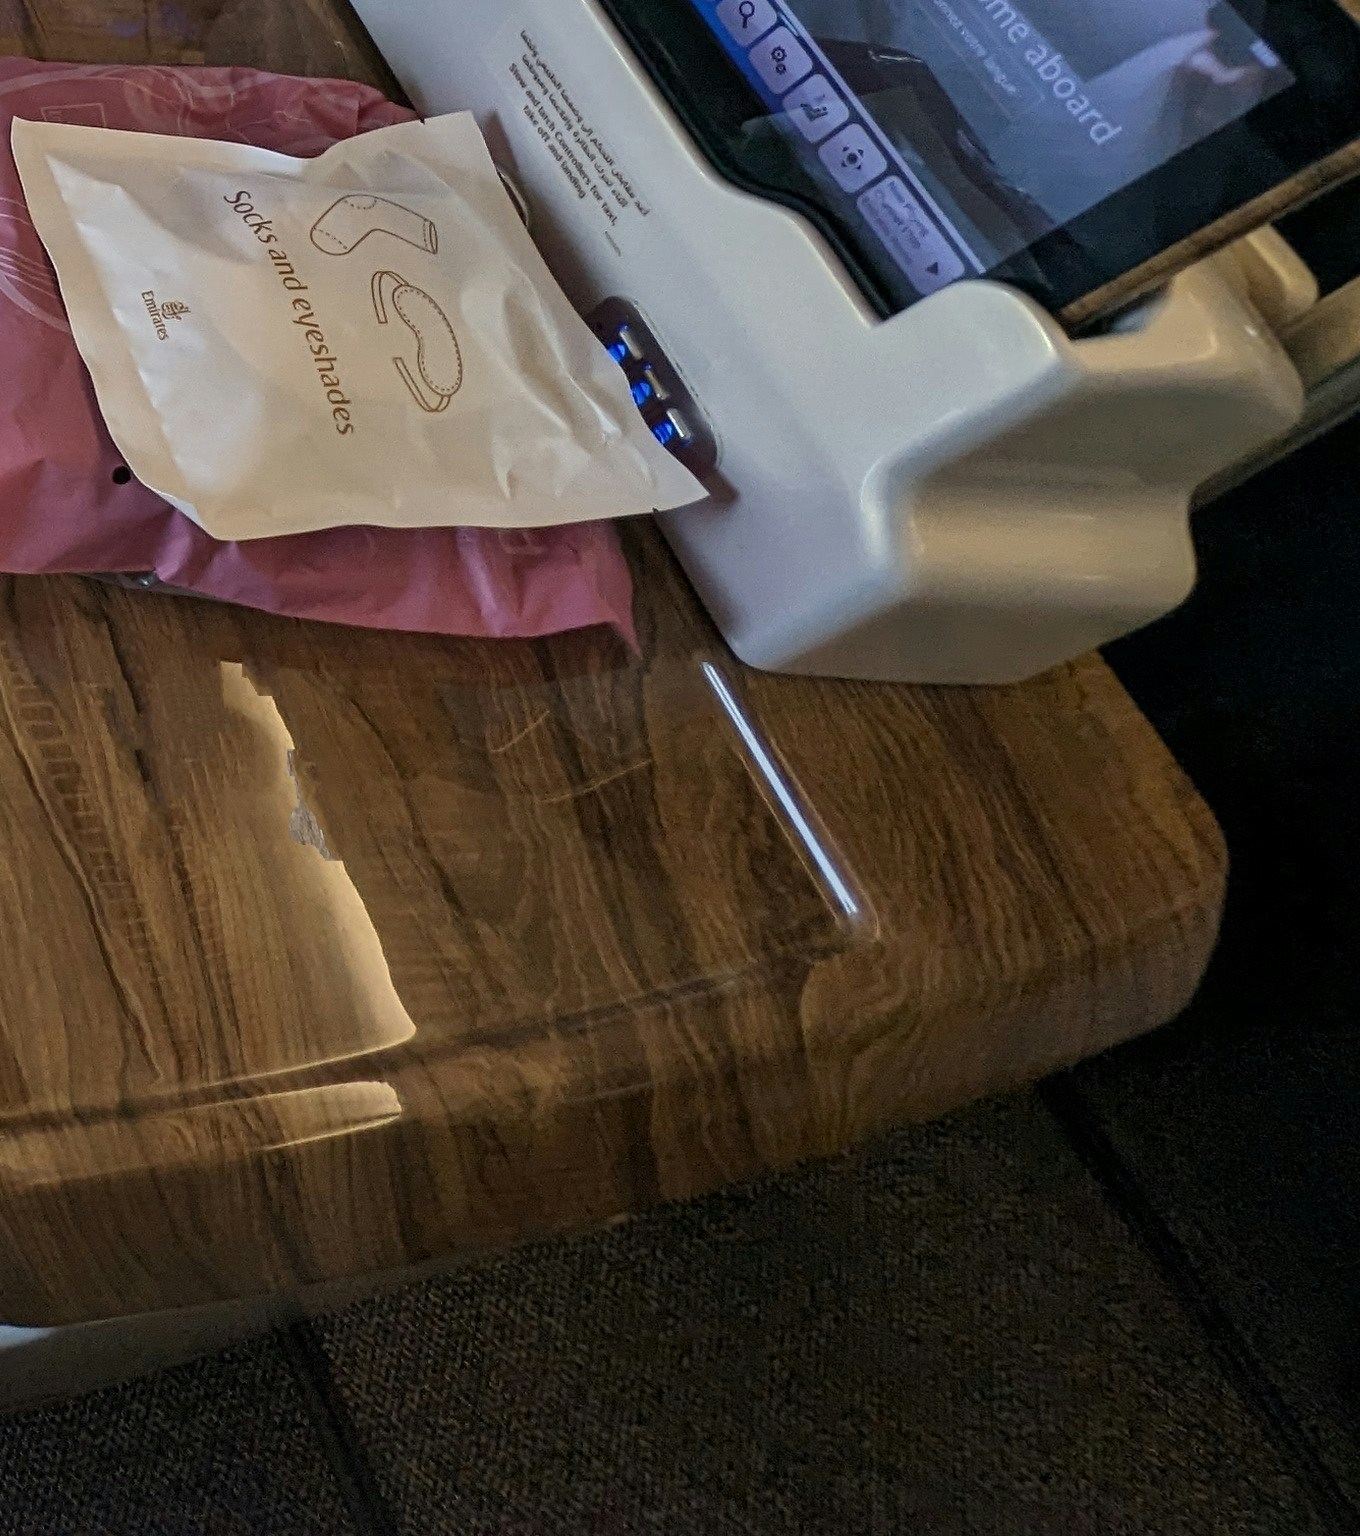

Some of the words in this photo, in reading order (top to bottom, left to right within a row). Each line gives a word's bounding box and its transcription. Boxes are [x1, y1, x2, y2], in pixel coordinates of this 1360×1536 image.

[509, 62, 528, 87] Stow
[526, 88, 540, 106] and
[538, 106, 556, 130] latch
[554, 130, 592, 185] Controllers
[590, 185, 602, 201] for
[600, 202, 618, 225] taxi,
[1024, 44, 1122, 145] aboard
[523, 105, 538, 125] take
[536, 125, 549, 142] off
[548, 142, 563, 161] and
[559, 161, 586, 198] landing
[142, 290, 169, 340] Emirates
[224, 190, 278, 244] Socks
[268, 249, 308, 291] and
[292, 297, 354, 436] eyeshades
